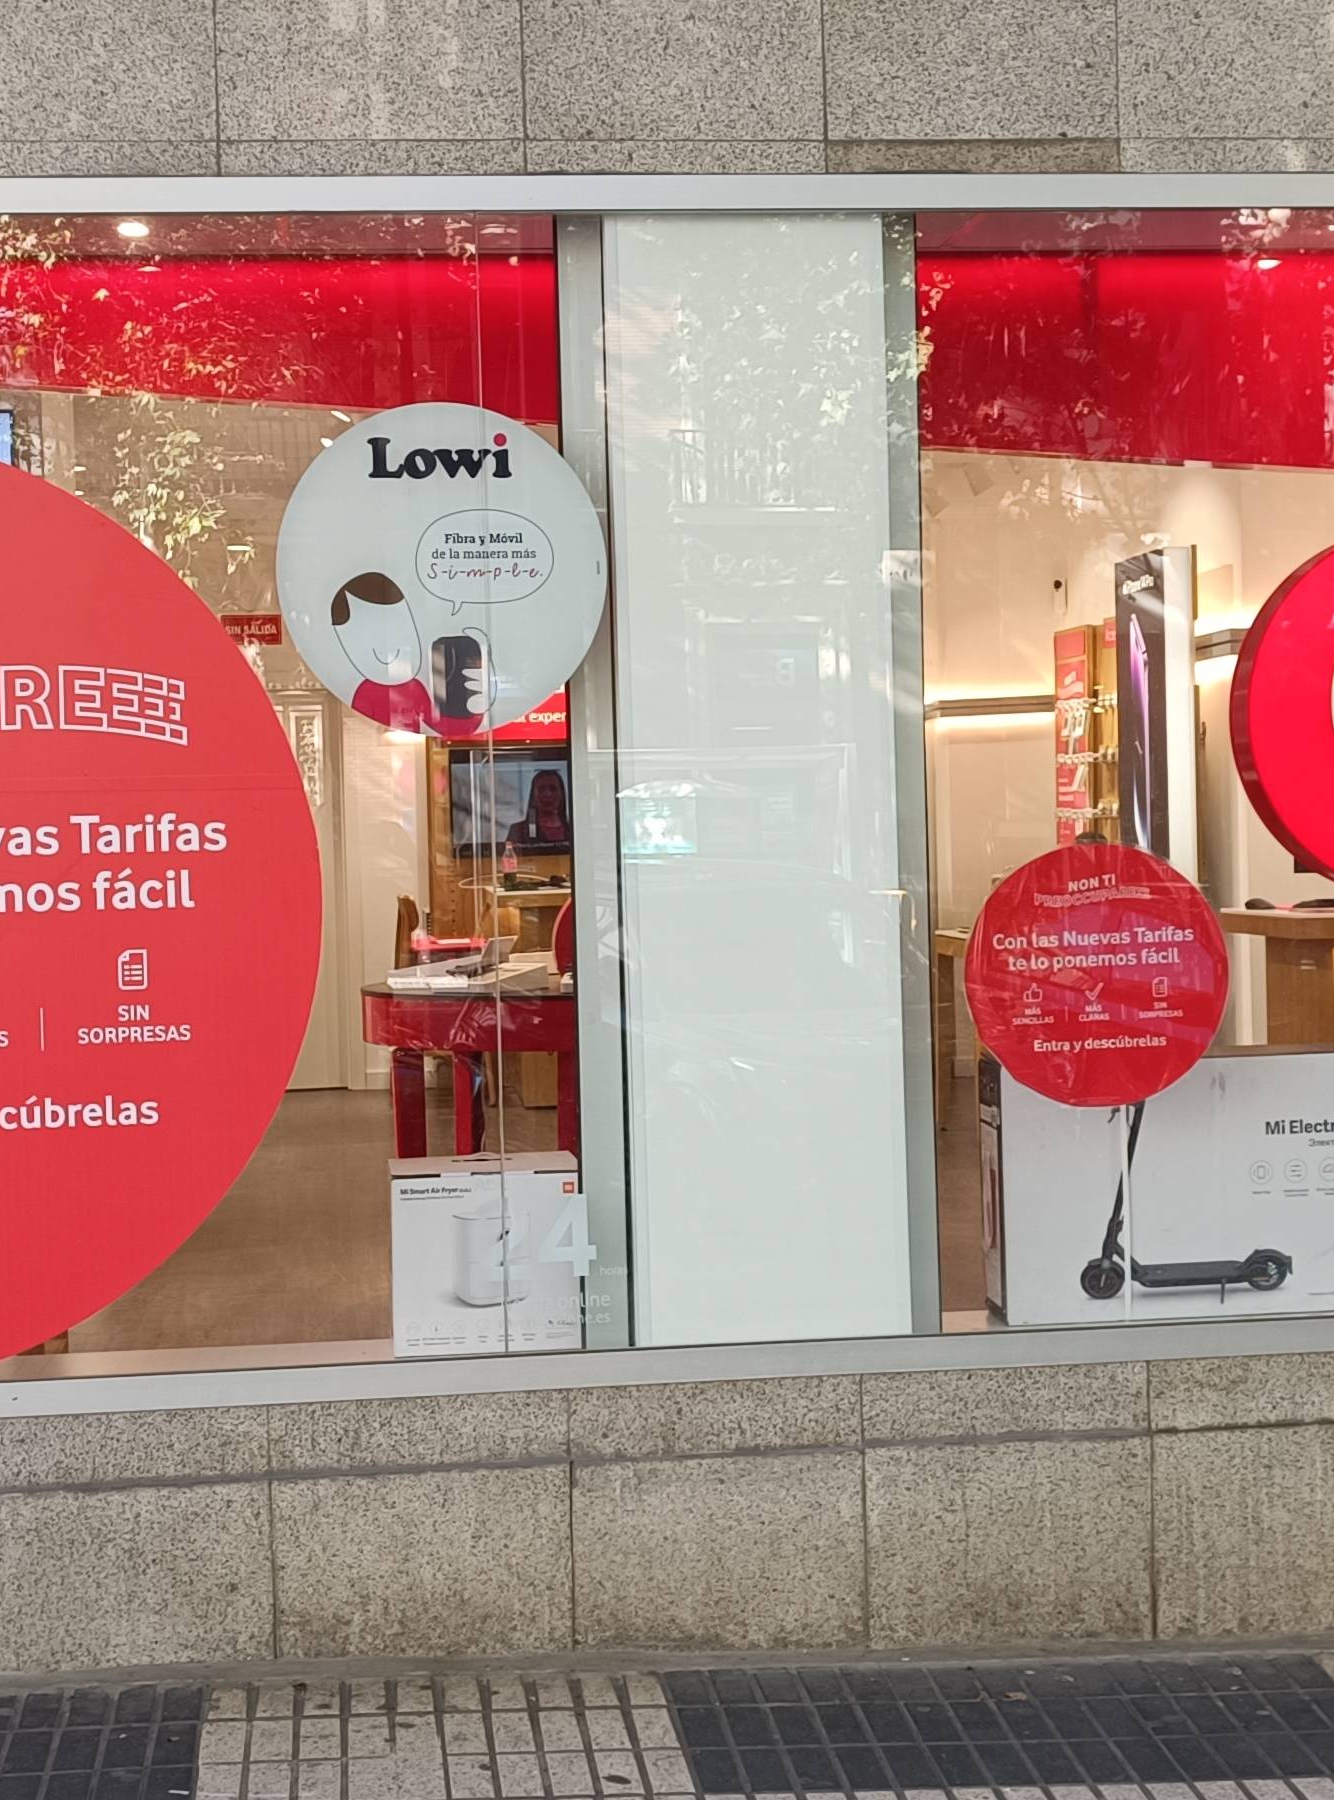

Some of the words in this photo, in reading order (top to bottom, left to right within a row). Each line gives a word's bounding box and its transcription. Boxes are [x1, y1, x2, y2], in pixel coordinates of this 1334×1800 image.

[367, 433, 512, 479] Lowi
[444, 532, 476, 544] Fibra
[478, 535, 487, 546] y
[489, 532, 523, 544] Móvil
[431, 548, 445, 559] de
[449, 548, 460, 559] la
[463, 550, 508, 559] manera
[511, 549, 536, 559] más
[225, 625, 241, 635] SIN
[70, 812, 228, 854] Tarifas
[92, 868, 196, 910] fácil
[1068, 876, 1099, 892] NON
[1101, 874, 1116, 886] TI
[993, 933, 1028, 950] Con
[1032, 931, 1060, 948] las
[1063, 929, 1131, 947] Nuevas
[1133, 925, 1195, 945] Tarifas
[1008, 955, 1026, 971] te
[1032, 953, 1049, 970] lo
[1053, 951, 1137, 972] ponemos
[1140, 947, 1181, 965] fácil
[117, 1004, 150, 1022] SIN
[77, 1024, 192, 1045] SORPRESAS
[1034, 1038, 1070, 1052] Entra
[1073, 1041, 1082, 1053] y
[1085, 1034, 1167, 1049] descúbrelas
[1265, 1119, 1286, 1136] Mi
